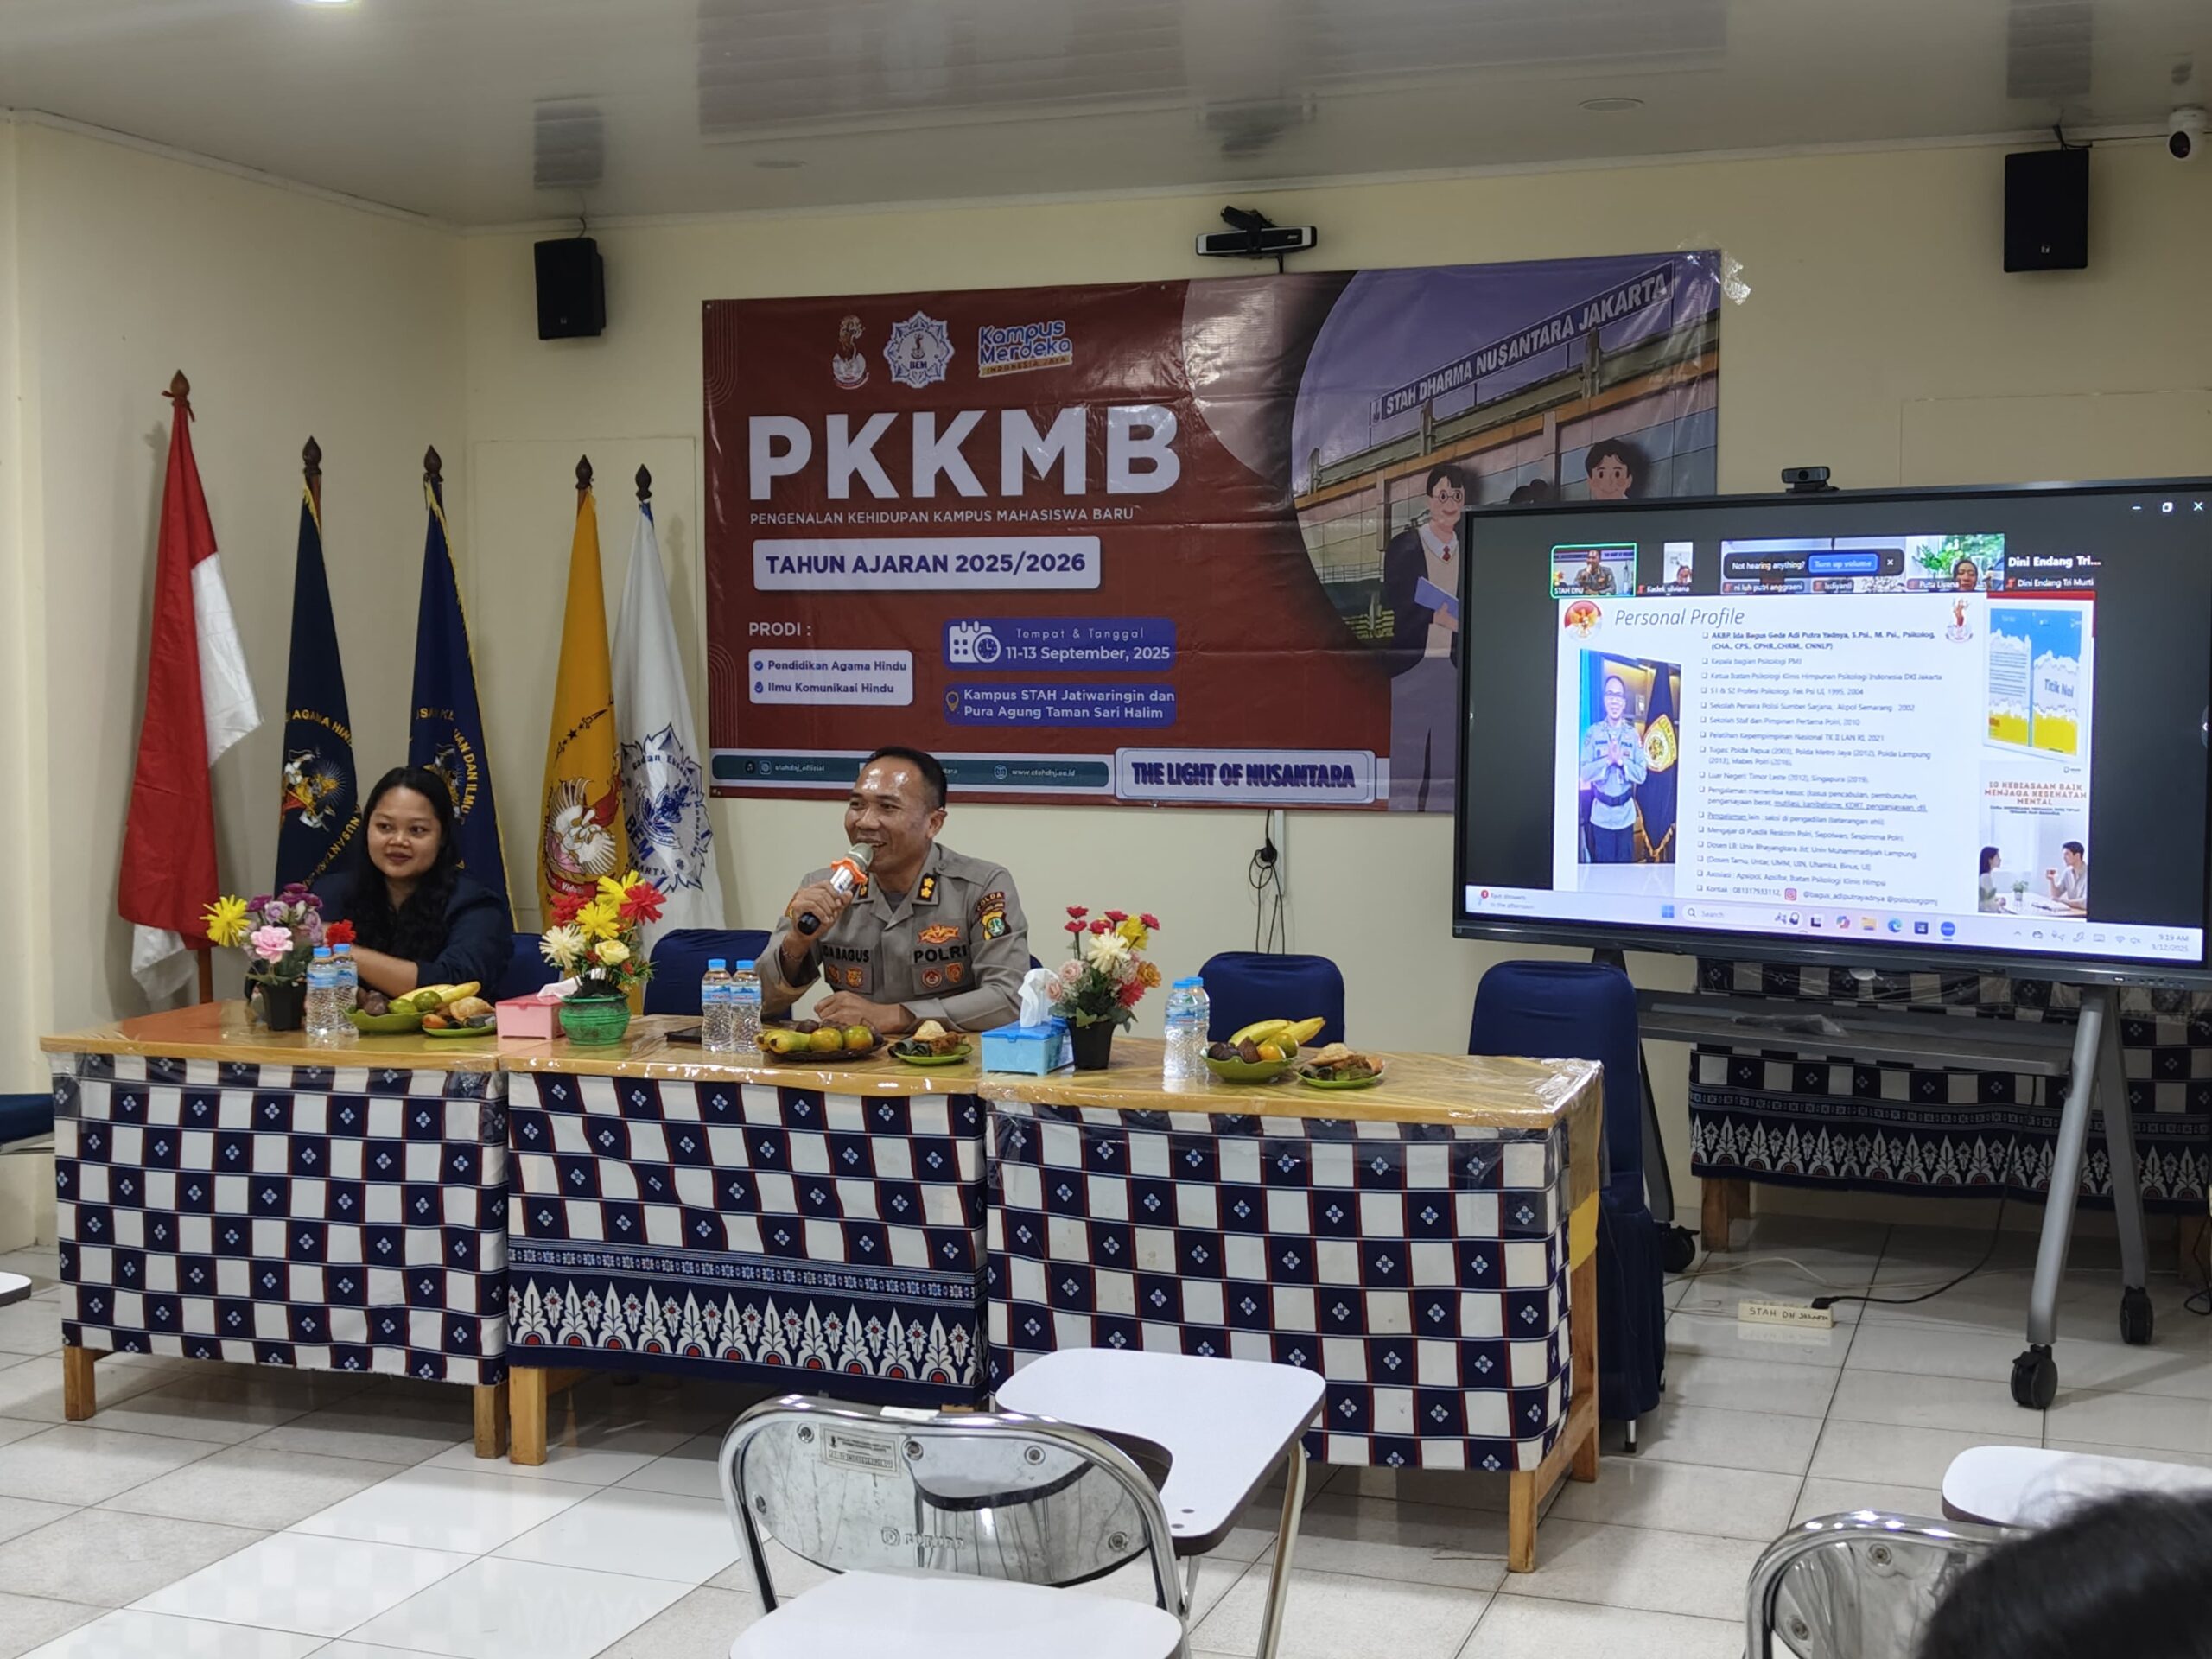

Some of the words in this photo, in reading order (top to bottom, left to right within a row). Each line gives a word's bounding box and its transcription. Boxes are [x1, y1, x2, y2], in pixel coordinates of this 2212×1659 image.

[980, 321, 1065, 344] Kampus
[1385, 386, 1417, 416] STAH
[1418, 360, 1473, 403] DHARMA
[1474, 315, 1574, 377] NUSANTARA
[1580, 271, 1669, 332] JAKARTA
[980, 340, 1071, 364] Merdeka
[909, 361, 927, 370] BEM
[749, 405, 1181, 500] PKKMB
[750, 512, 843, 525] PENGENALAN
[848, 510, 929, 524] KEHIDUPAN
[932, 509, 992, 522] KAMPUS
[996, 506, 1088, 521] MAHASISWA
[1092, 507, 1134, 520] BARU
[766, 554, 847, 575] TAHUN
[851, 553, 949, 574] AJARAN
[955, 550, 1086, 575] 2025/2026
[1746, 562, 1770, 571] hearing
[1772, 561, 1806, 570] anything?
[2009, 556, 2029, 567] Dini
[2033, 556, 2072, 568] Endang
[2076, 556, 2101, 566] Tri...
[2034, 579, 2062, 588] Endang
[1615, 608, 1686, 626] Personal
[1690, 607, 1745, 628] Profile
[748, 621, 801, 638] PRODI
[1016, 627, 1065, 642] Tempat
[1072, 627, 1081, 639] &
[1088, 627, 1144, 642] Tanggal
[1745, 632, 1767, 640] Bagus
[1006, 646, 1037, 660] 11-13
[1040, 645, 1130, 664] September,
[1134, 646, 1170, 660] 2025
[767, 659, 830, 672] Pendidikan
[831, 660, 872, 674] Agama
[874, 660, 907, 672] Hindu
[767, 682, 791, 693] Ilmu
[794, 681, 858, 694] Komunikasi
[861, 682, 894, 695] Hindu
[2044, 678, 2059, 694] Titik
[2061, 683, 2074, 698] Nol
[963, 689, 1017, 704] Kampus
[1020, 689, 1057, 702] STAH
[1061, 689, 1145, 706] Jatiwaringin
[1148, 690, 1175, 702] dan
[963, 705, 994, 718] Pura
[997, 705, 1042, 721] Agung
[1046, 706, 1090, 719] Taman
[1093, 706, 1121, 719] Sari
[1124, 707, 1164, 720] Halim
[1131, 762, 1165, 785] THE
[1166, 762, 1216, 786] LIGHT
[1219, 764, 1243, 786] OF
[1249, 764, 1357, 789] NUSANTARA
[2002, 781, 2056, 791] KEBIASAAN
[2032, 790, 2087, 798] KESEHATAN
[1700, 910, 1724, 919] Search
[836, 948, 870, 963] BAGUS
[913, 944, 968, 963] POLRI
[1749, 1306, 1777, 1317] STAH
